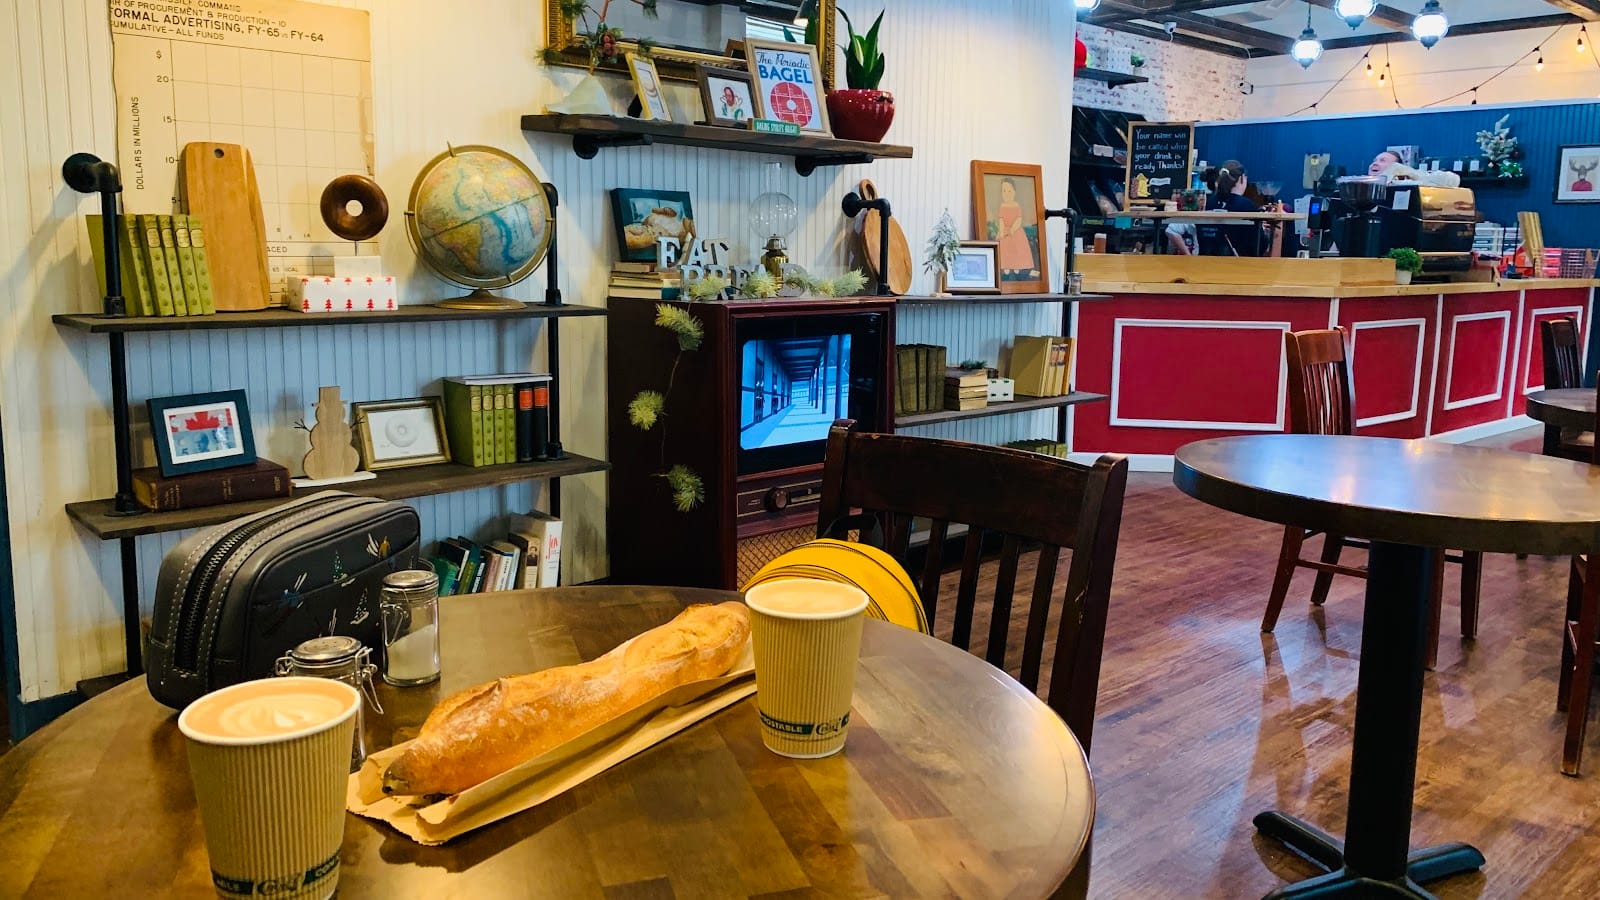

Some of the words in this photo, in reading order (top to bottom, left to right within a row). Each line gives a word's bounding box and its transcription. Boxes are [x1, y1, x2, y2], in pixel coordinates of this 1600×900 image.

[124, 0, 135, 8] OF
[138, 2, 204, 17] PROCUREMENT
[217, 12, 270, 26] PRODUCTION
[111, 8, 159, 22] ORMAL
[248, 25, 280, 38] FY-65
[290, 30, 324, 42] FY-64
[196, 30, 225, 40] FUNDS
[156, 50, 162, 60] $
[756, 52, 773, 65] The
[776, 53, 810, 69] Periodic
[156, 75, 169, 83] 20
[758, 64, 813, 84] BAGEL
[131, 97, 140, 137] MILLIONS
[1136, 129, 1151, 140] Your
[133, 138, 141, 147] IN
[1136, 142, 1147, 150] be
[165, 156, 175, 165] 10
[1135, 153, 1151, 162] your
[1154, 152, 1172, 160] drink
[135, 149, 145, 190] DOLLARS
[1134, 162, 1155, 173] ready
[1158, 160, 1185, 169] Thanks!
[656, 233, 730, 270] EAT
